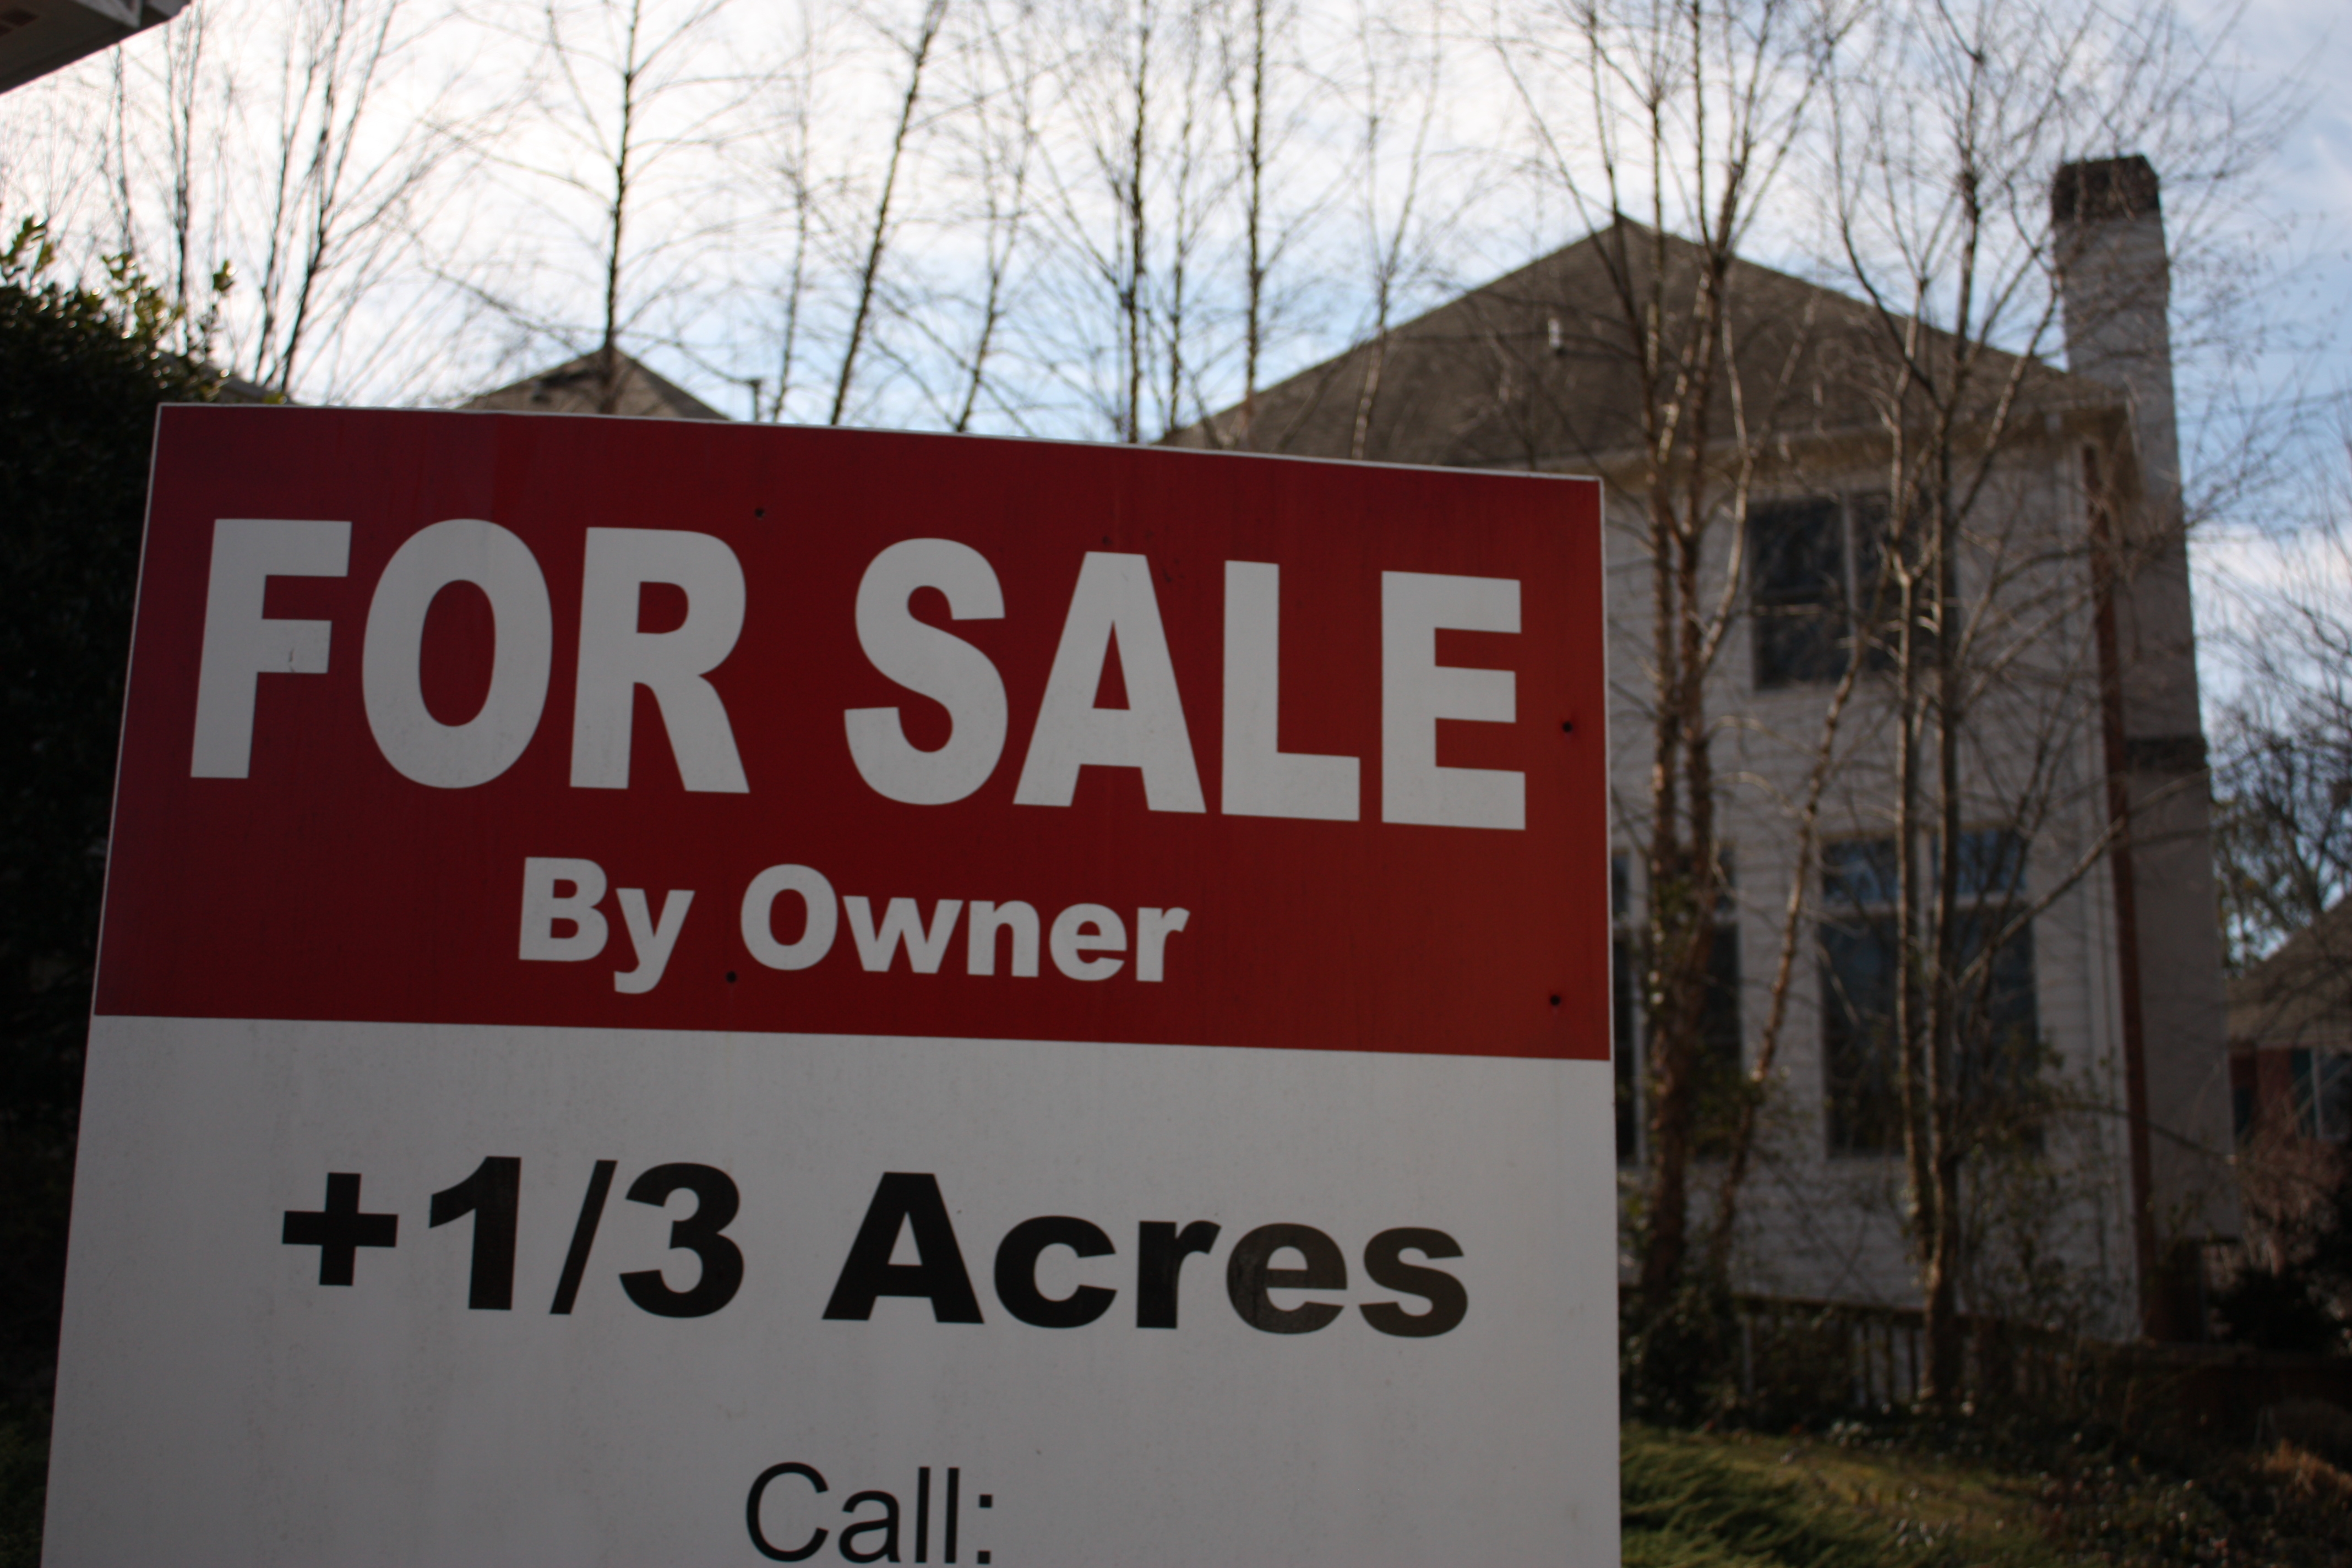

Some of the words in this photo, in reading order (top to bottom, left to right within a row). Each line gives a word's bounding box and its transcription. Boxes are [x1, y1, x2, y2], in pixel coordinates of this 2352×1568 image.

[190, 518, 749, 794] FOR
[844, 537, 1527, 831] SALE
[518, 857, 695, 995] By
[740, 864, 1189, 983] Owner
[281, 1155, 745, 1319] +1/3
[821, 1172, 1469, 1338] Acres
[745, 1461, 994, 1565] Call:
